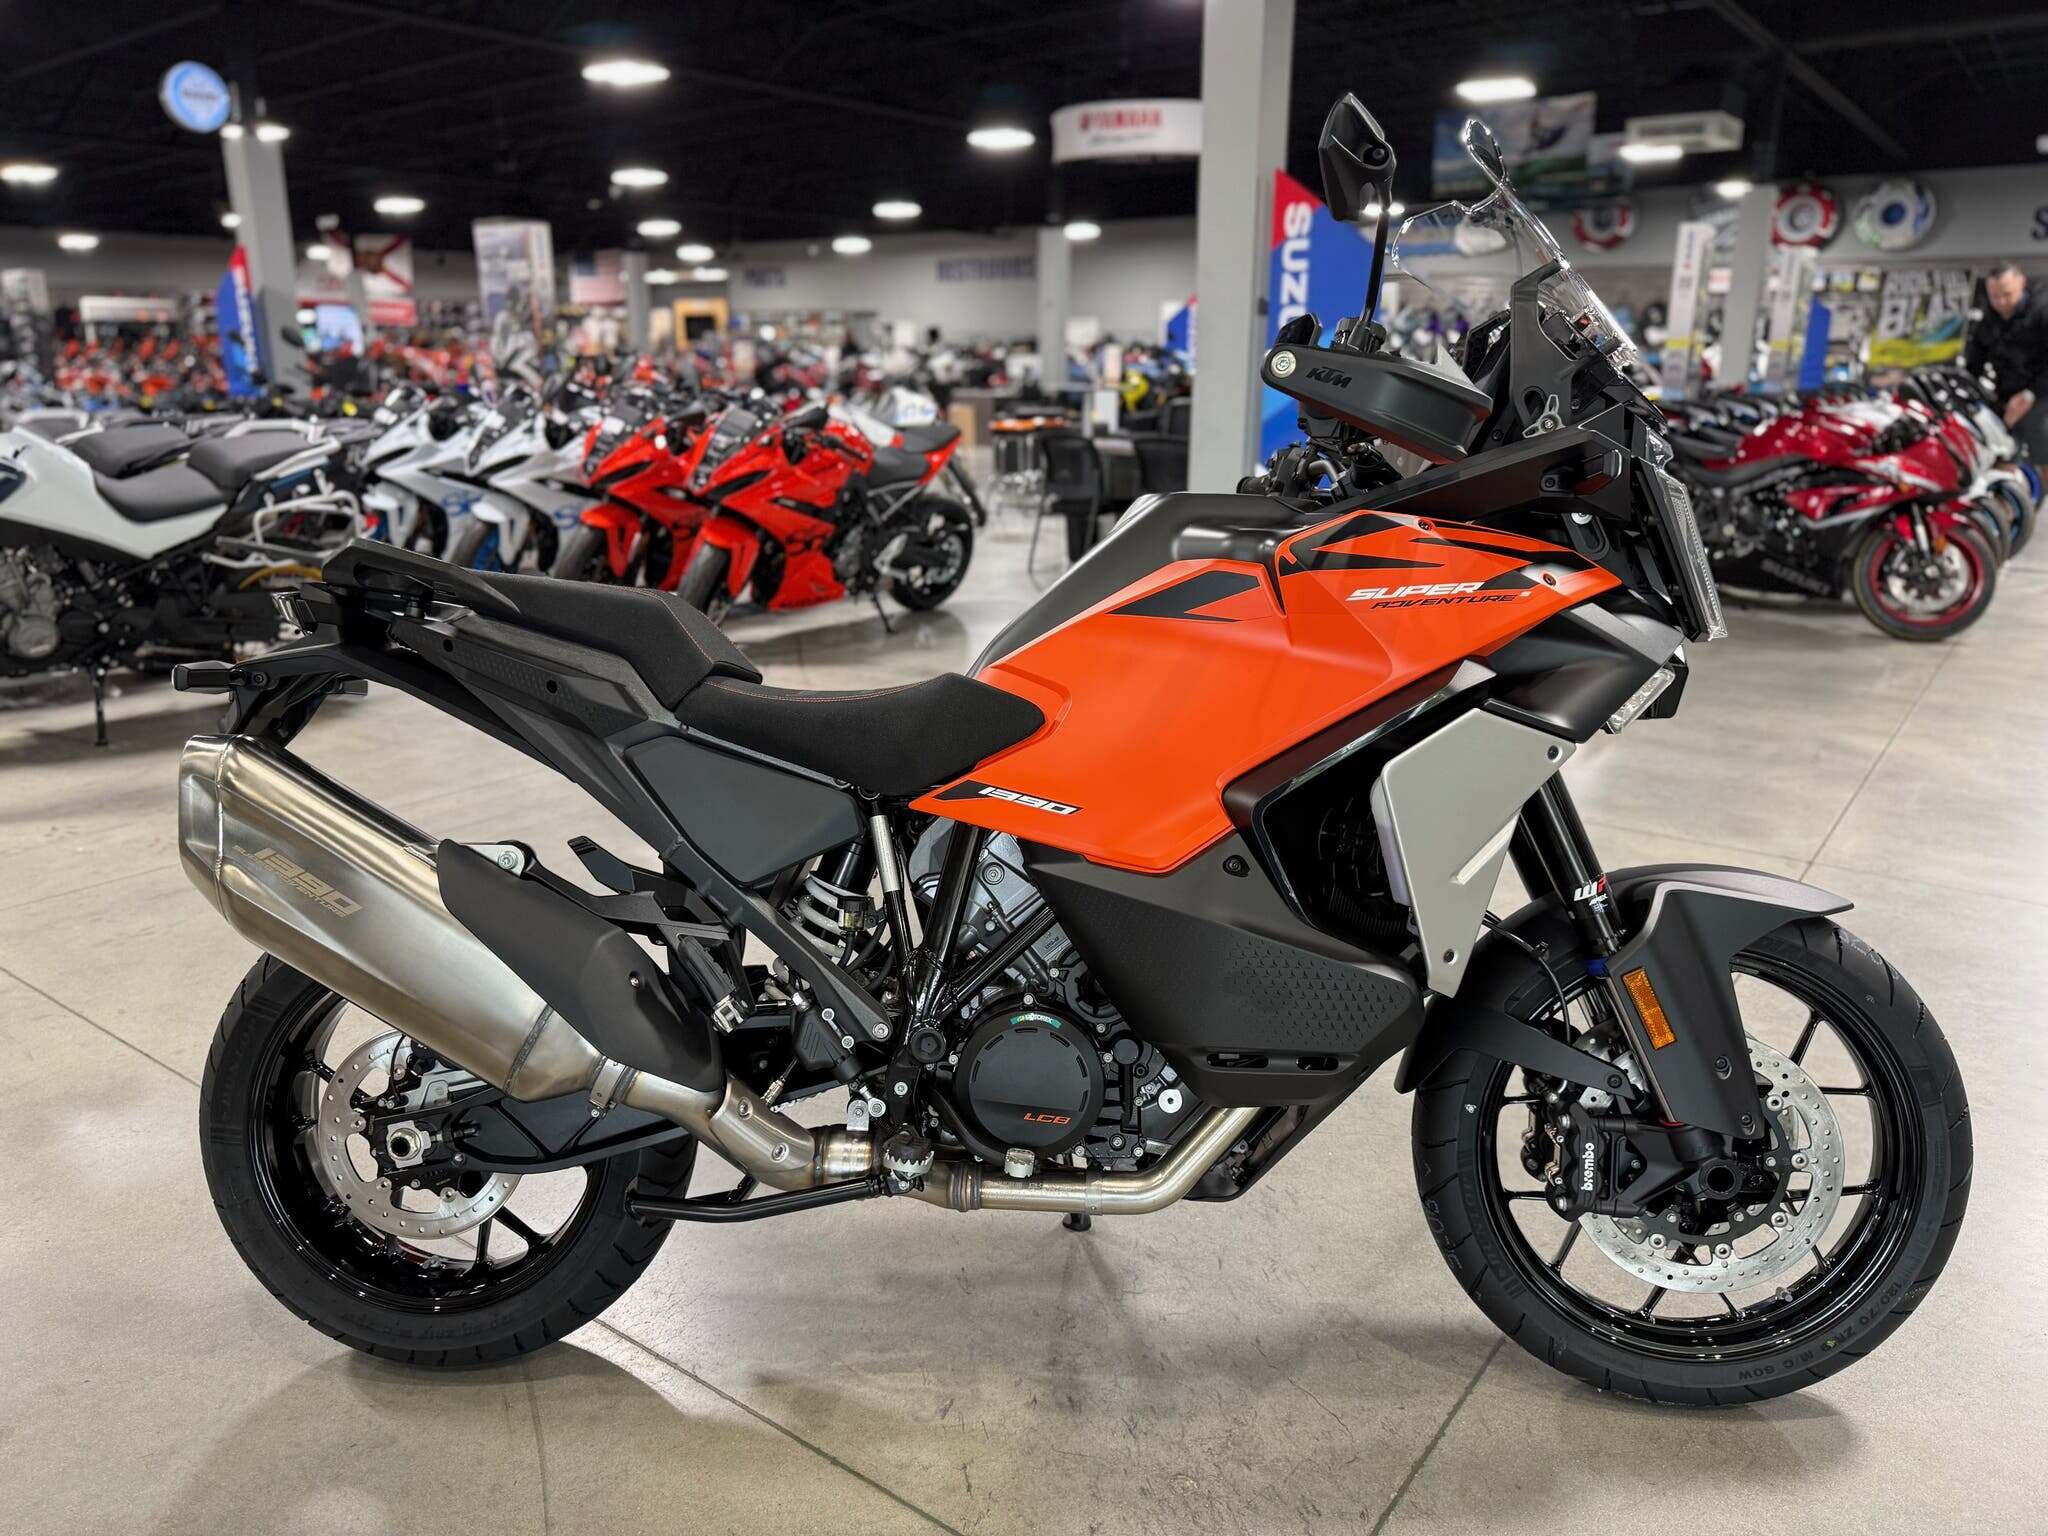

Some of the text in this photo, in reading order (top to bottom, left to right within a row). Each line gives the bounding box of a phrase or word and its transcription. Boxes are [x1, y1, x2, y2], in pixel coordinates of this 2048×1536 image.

[1305, 366, 1352, 389] KTM
[1345, 581, 1485, 601] SUPER
[1370, 594, 1517, 609] ADVENTURE
[1023, 1112, 1072, 1125] LC8
[1581, 1142, 1595, 1191] brembo
